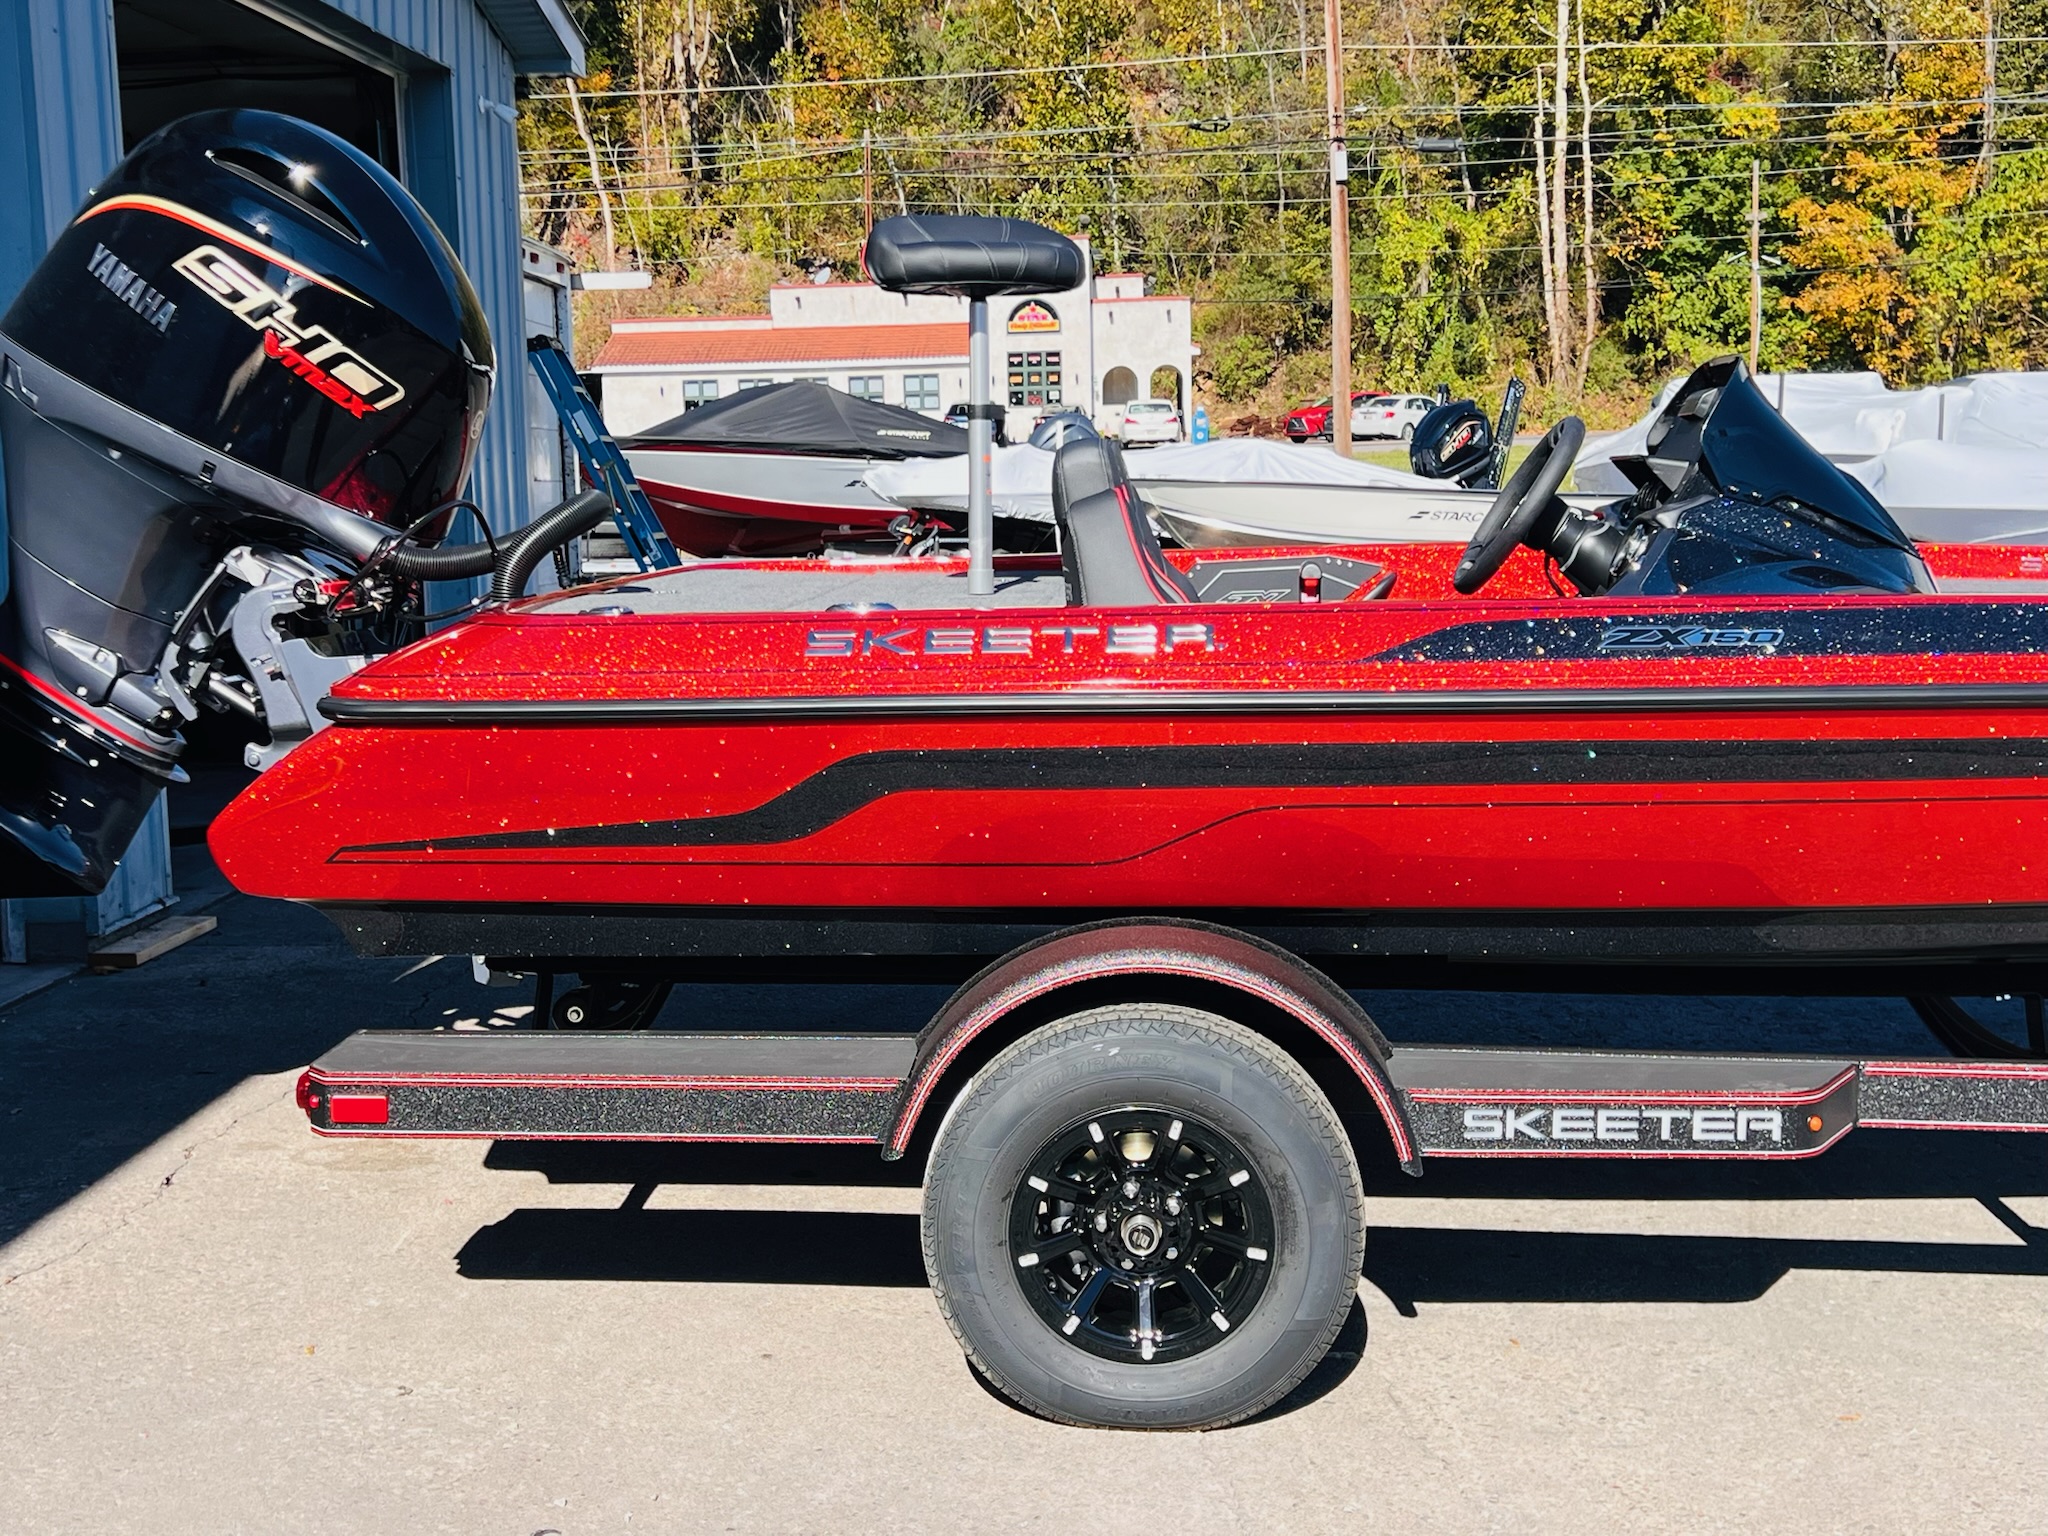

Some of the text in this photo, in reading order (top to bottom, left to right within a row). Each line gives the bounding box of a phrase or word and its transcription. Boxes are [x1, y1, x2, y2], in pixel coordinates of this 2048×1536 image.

[87, 243, 178, 333] YAMAHA
[804, 626, 1215, 656] SKEETER
[1463, 1109, 1783, 1141] SKEETER
